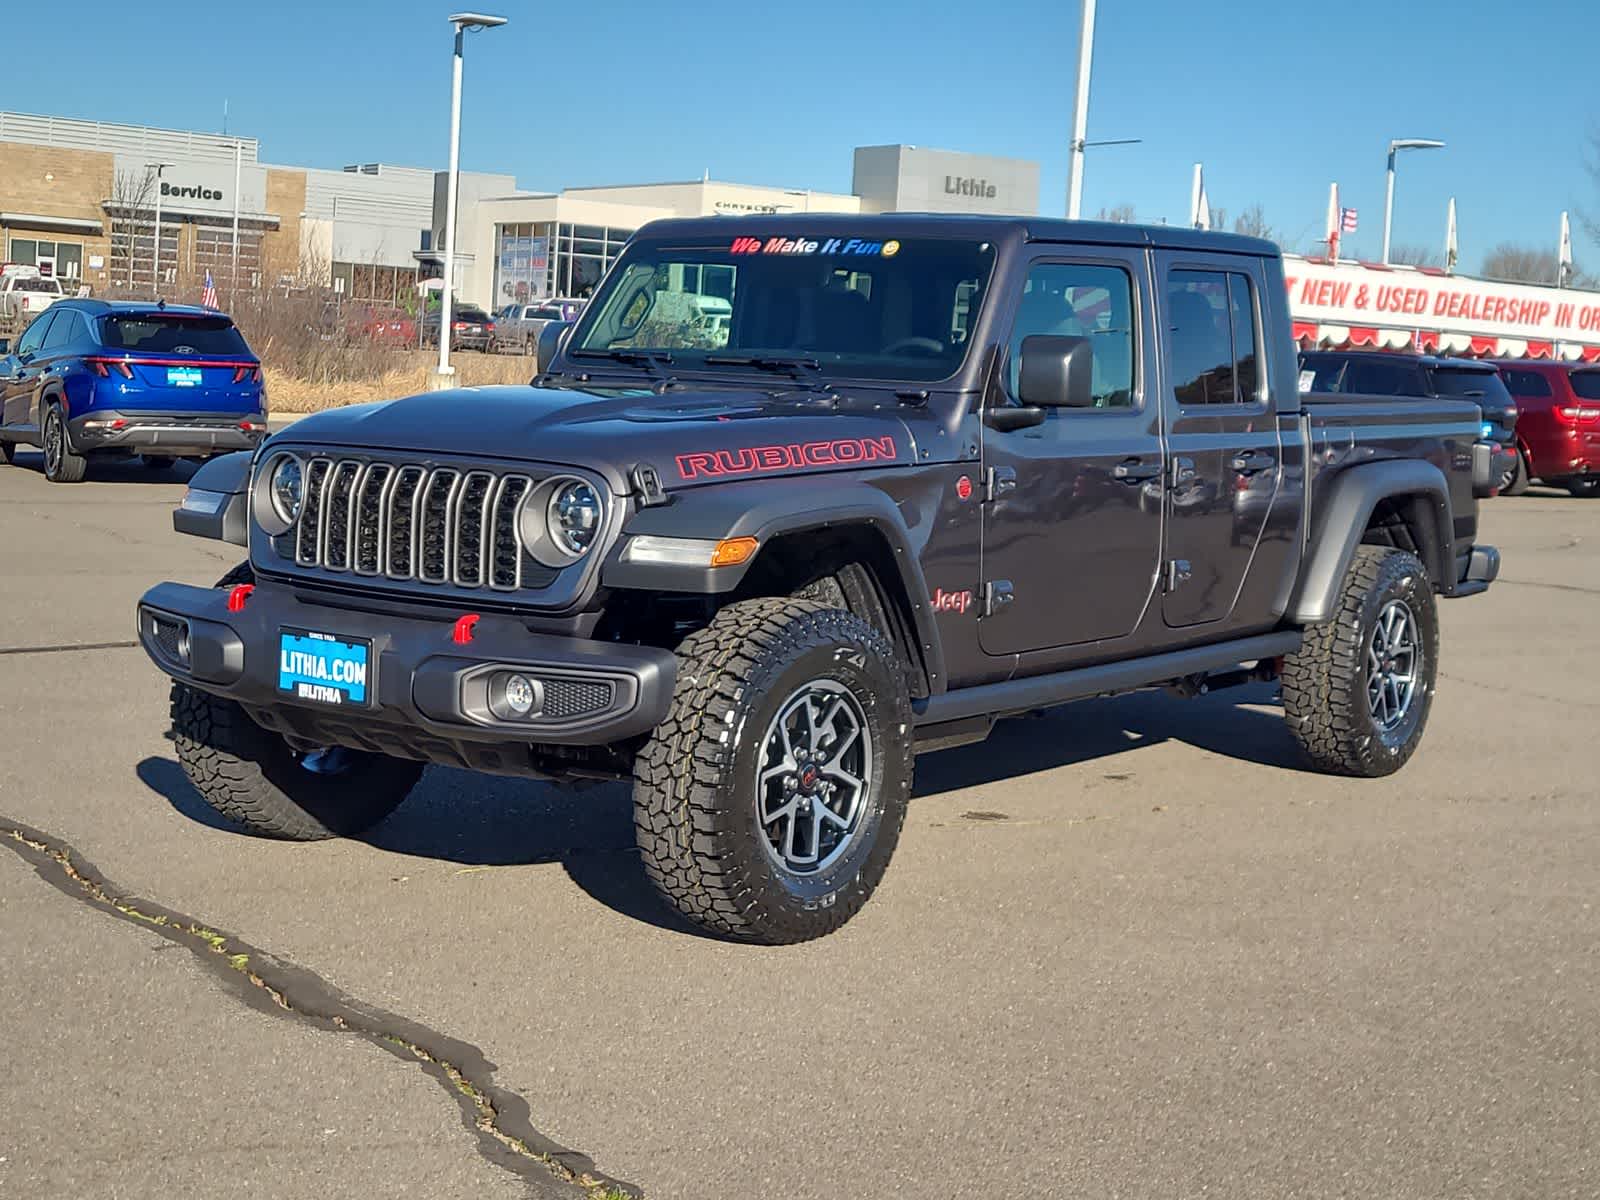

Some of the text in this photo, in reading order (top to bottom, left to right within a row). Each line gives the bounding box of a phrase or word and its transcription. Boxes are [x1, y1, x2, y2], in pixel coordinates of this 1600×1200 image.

[161, 182, 222, 200] Service
[945, 175, 996, 198] Lithia
[731, 237, 882, 254] We Make It Fun
[1301, 279, 1351, 307] NEW
[1354, 283, 1369, 310] &
[1376, 285, 1428, 314] USED
[1433, 291, 1551, 326] DEALERSHIP
[1555, 302, 1575, 328] IN
[675, 437, 896, 479] RUBICON
[929, 587, 972, 614] Jeep
[281, 649, 366, 686] LITHIA.COM
